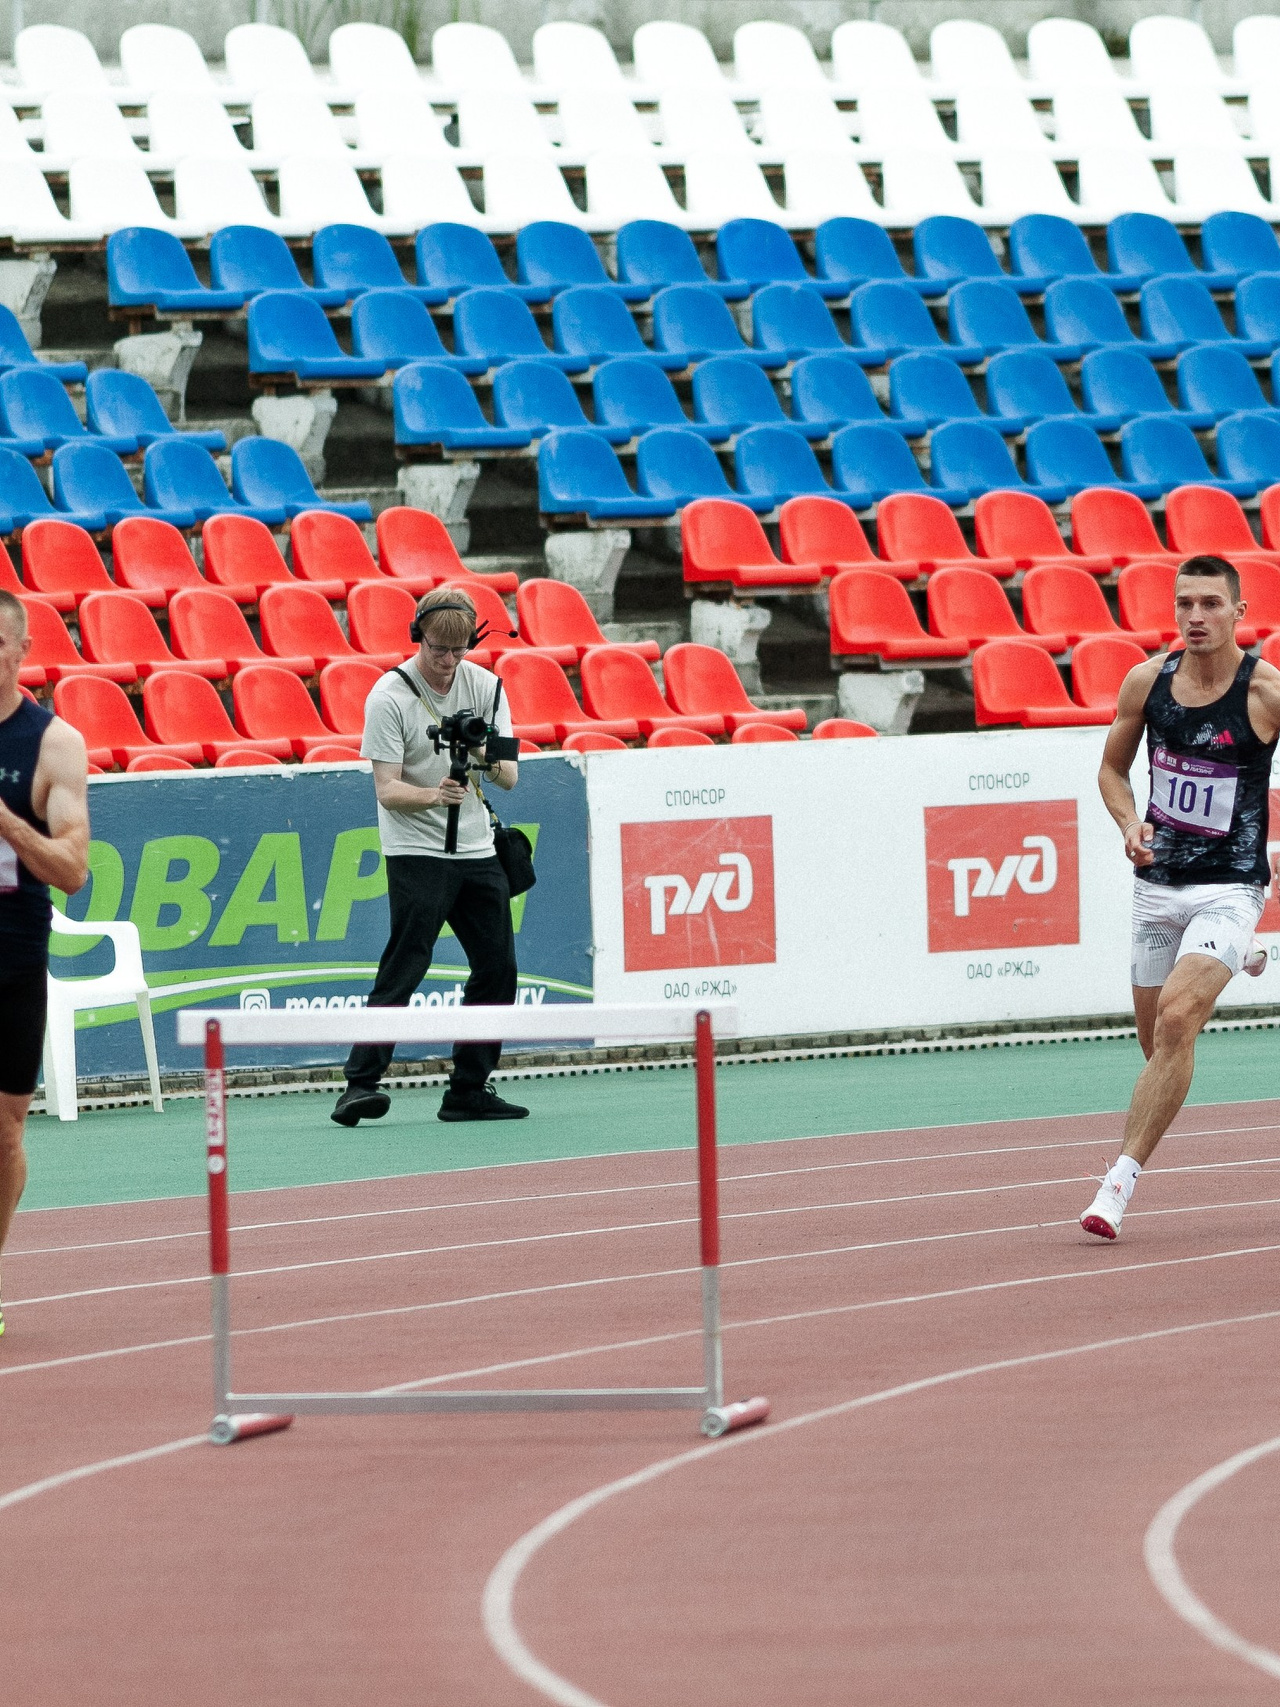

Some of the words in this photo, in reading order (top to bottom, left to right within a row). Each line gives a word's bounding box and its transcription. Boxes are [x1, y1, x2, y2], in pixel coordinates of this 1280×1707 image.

[968, 772, 1030, 790] СПОНСОР
[665, 788, 726, 807] СПОНСОР
[1168, 776, 1214, 818] 101
[967, 963, 992, 979] ОАО
[997, 960, 1040, 978] «РЖД»
[664, 982, 690, 999] ОАО
[695, 979, 738, 997] «РЖД»
